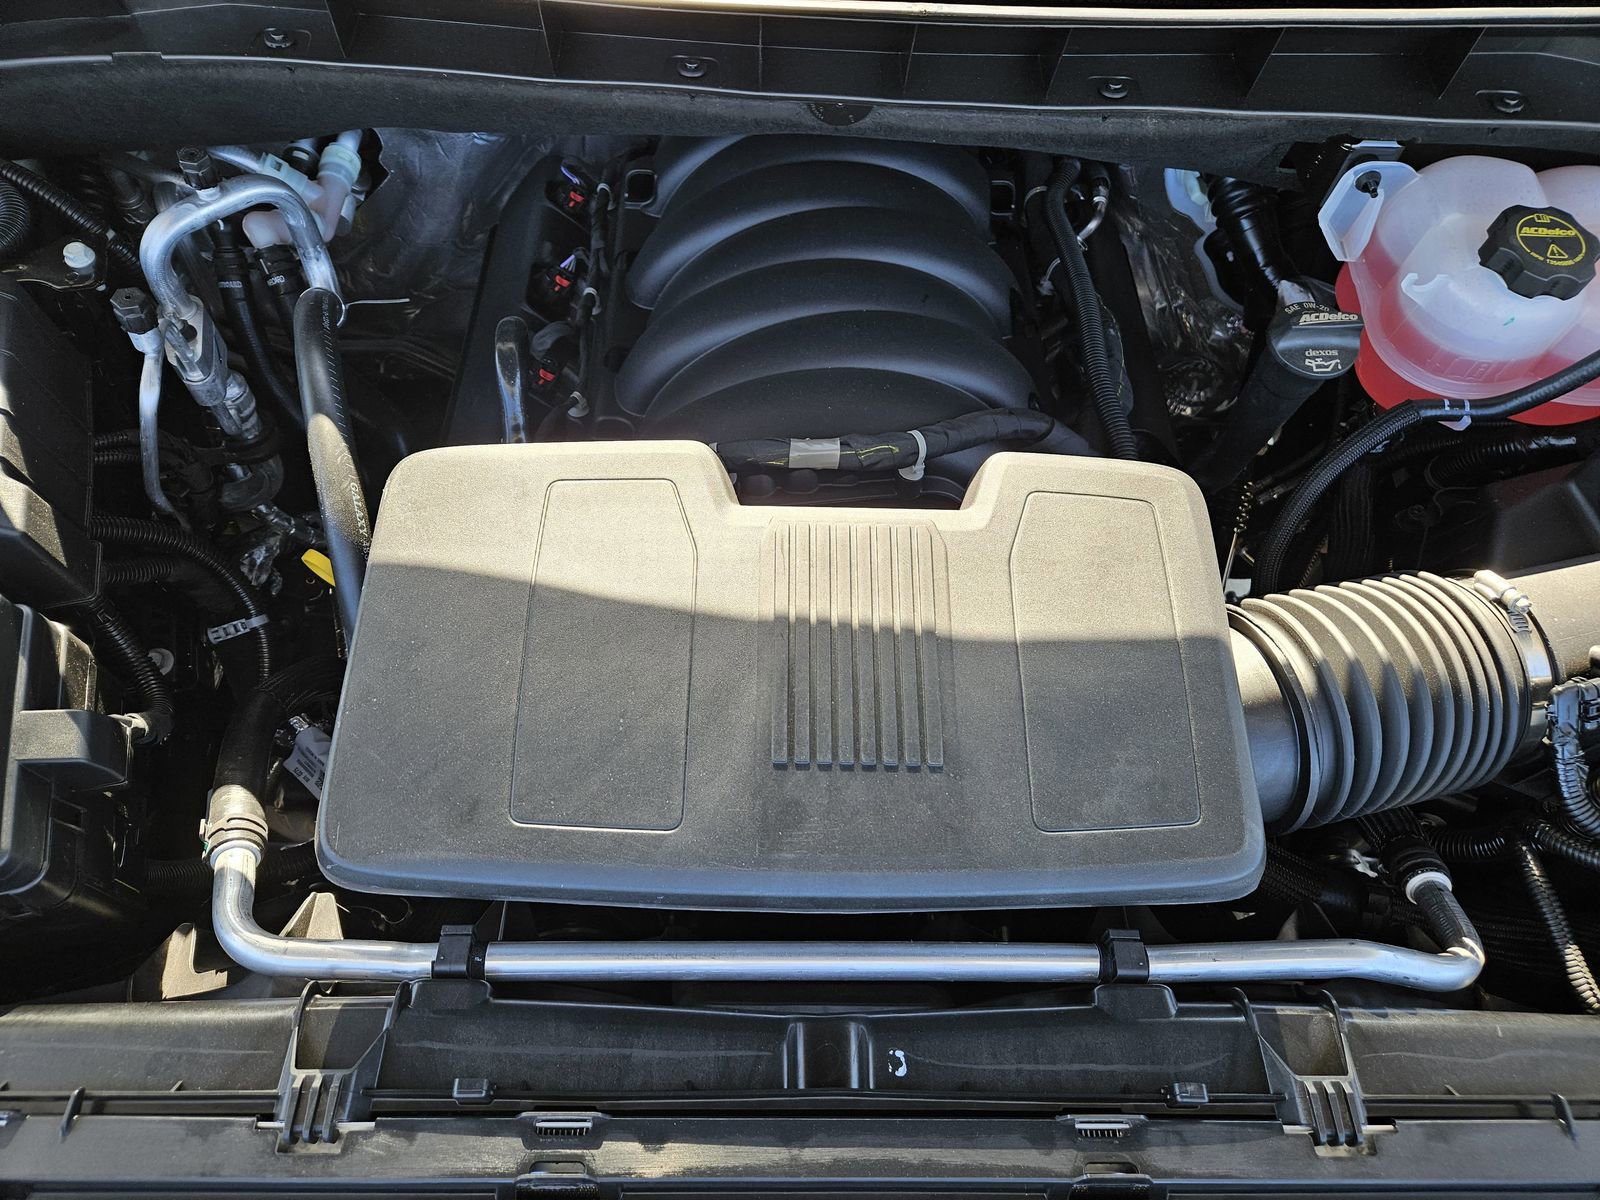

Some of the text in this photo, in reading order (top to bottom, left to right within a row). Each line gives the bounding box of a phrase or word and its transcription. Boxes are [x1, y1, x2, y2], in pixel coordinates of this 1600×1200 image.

[1520, 226, 1576, 236] ACDelco
[1284, 303, 1301, 314] SAE
[1299, 312, 1358, 323] ACDelco
[1305, 348, 1338, 356] dexos
[350, 482, 369, 538] GALAXY
